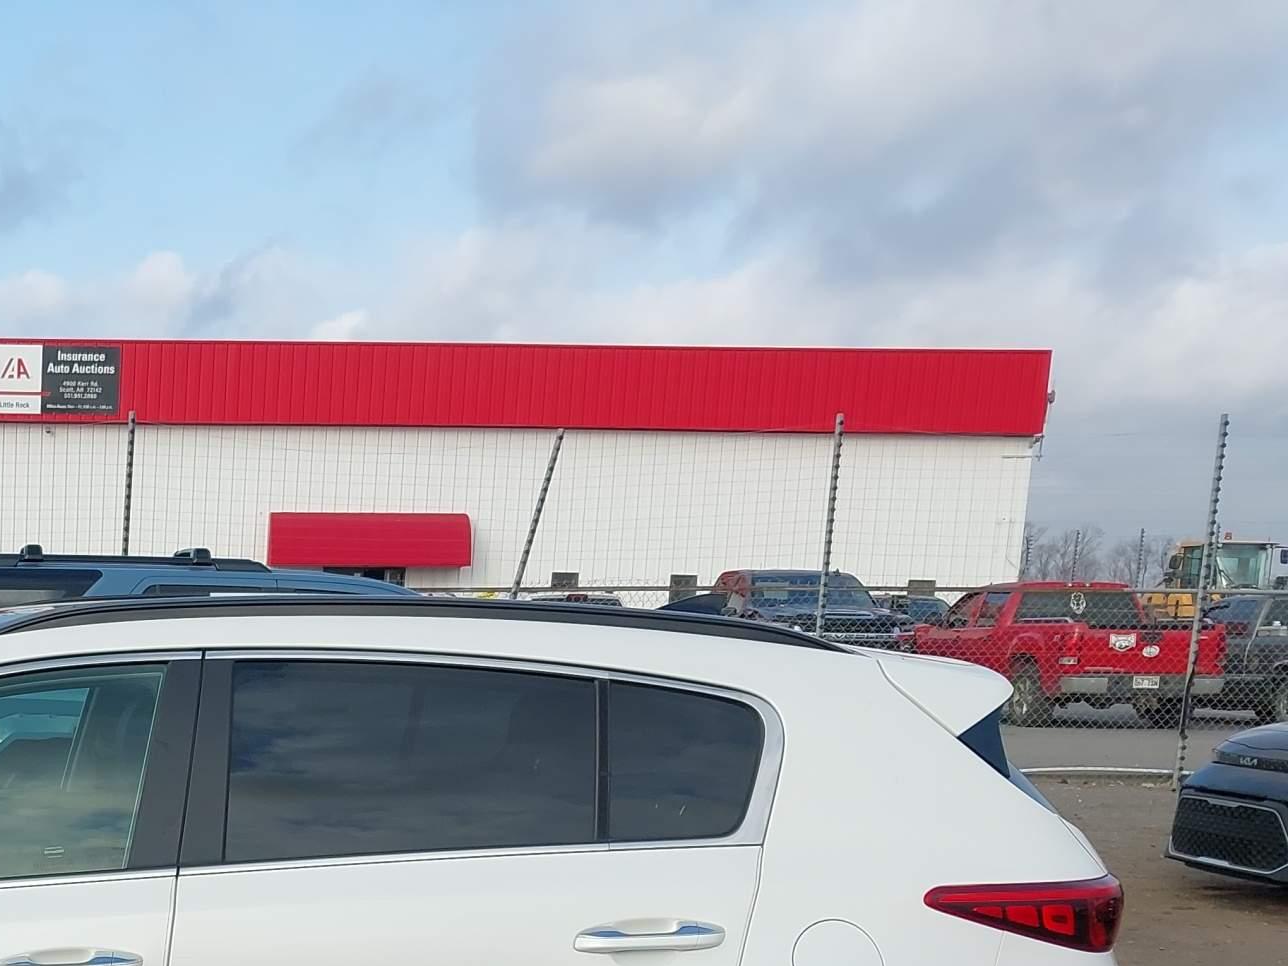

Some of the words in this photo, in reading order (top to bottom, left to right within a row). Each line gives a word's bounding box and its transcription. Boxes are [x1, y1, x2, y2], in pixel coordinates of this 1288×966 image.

[58, 350, 106, 361] Insurance
[47, 363, 70, 374] Auto
[72, 363, 116, 375] Auctions
[0, 401, 14, 409] Little
[15, 401, 30, 409] Rock
